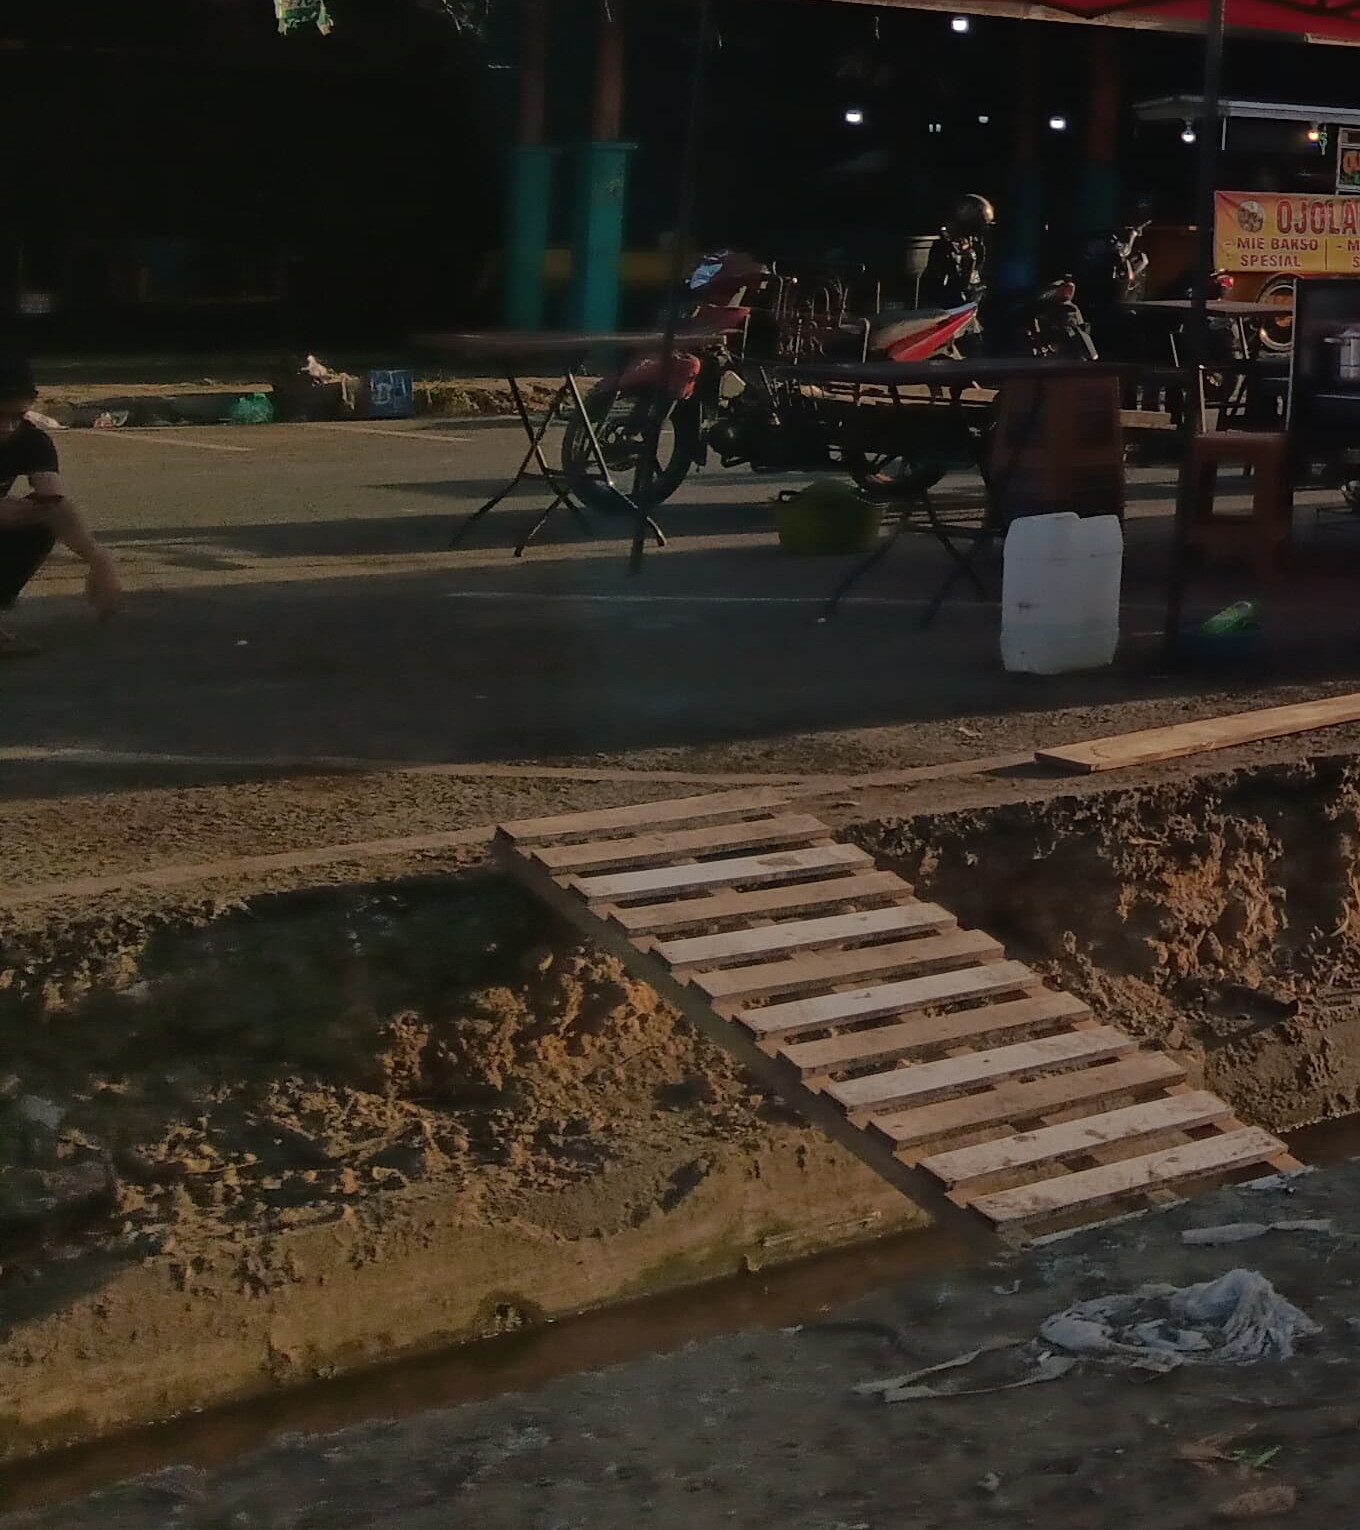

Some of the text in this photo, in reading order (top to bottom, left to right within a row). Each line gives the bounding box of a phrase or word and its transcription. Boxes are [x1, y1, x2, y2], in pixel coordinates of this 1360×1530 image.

[1237, 237, 1318, 251] MIE BAKSO
[1240, 254, 1301, 268] SPESIAL
